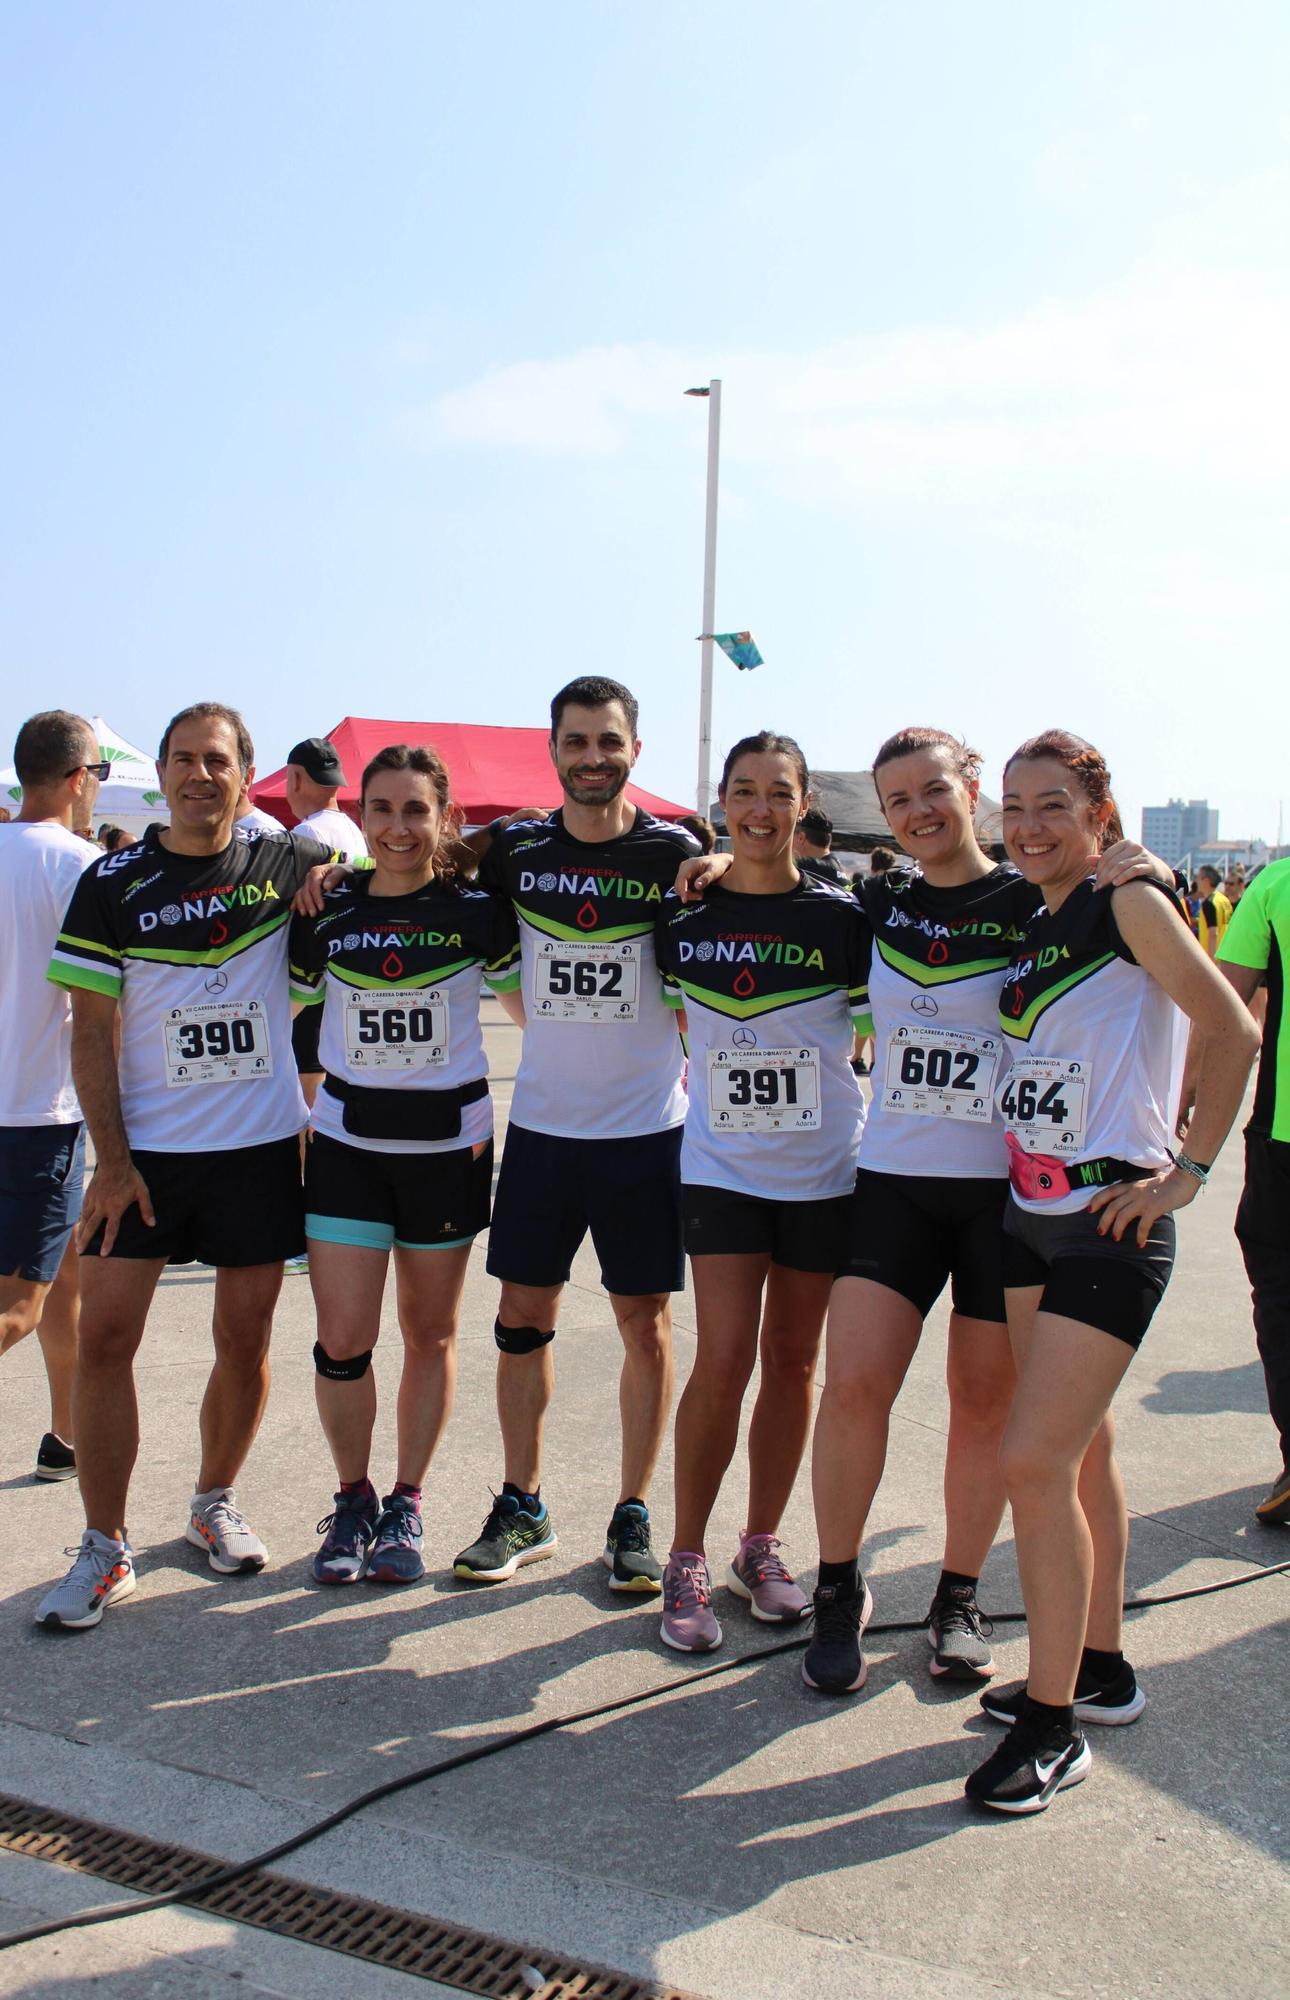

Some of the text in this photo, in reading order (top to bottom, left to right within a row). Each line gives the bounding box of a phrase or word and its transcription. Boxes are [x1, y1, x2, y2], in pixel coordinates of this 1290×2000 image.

[560, 866, 624, 877] CARRERA
[717, 933, 783, 942] CARRERA
[549, 960, 622, 997] 562
[193, 1004, 216, 1012] CARRERA
[359, 1008, 432, 1044] 560
[179, 1019, 255, 1059] 390
[920, 1028, 944, 1036] CARRERA
[728, 1068, 797, 1105] 391
[900, 1046, 980, 1091] 602
[1001, 1079, 1068, 1124] 464
